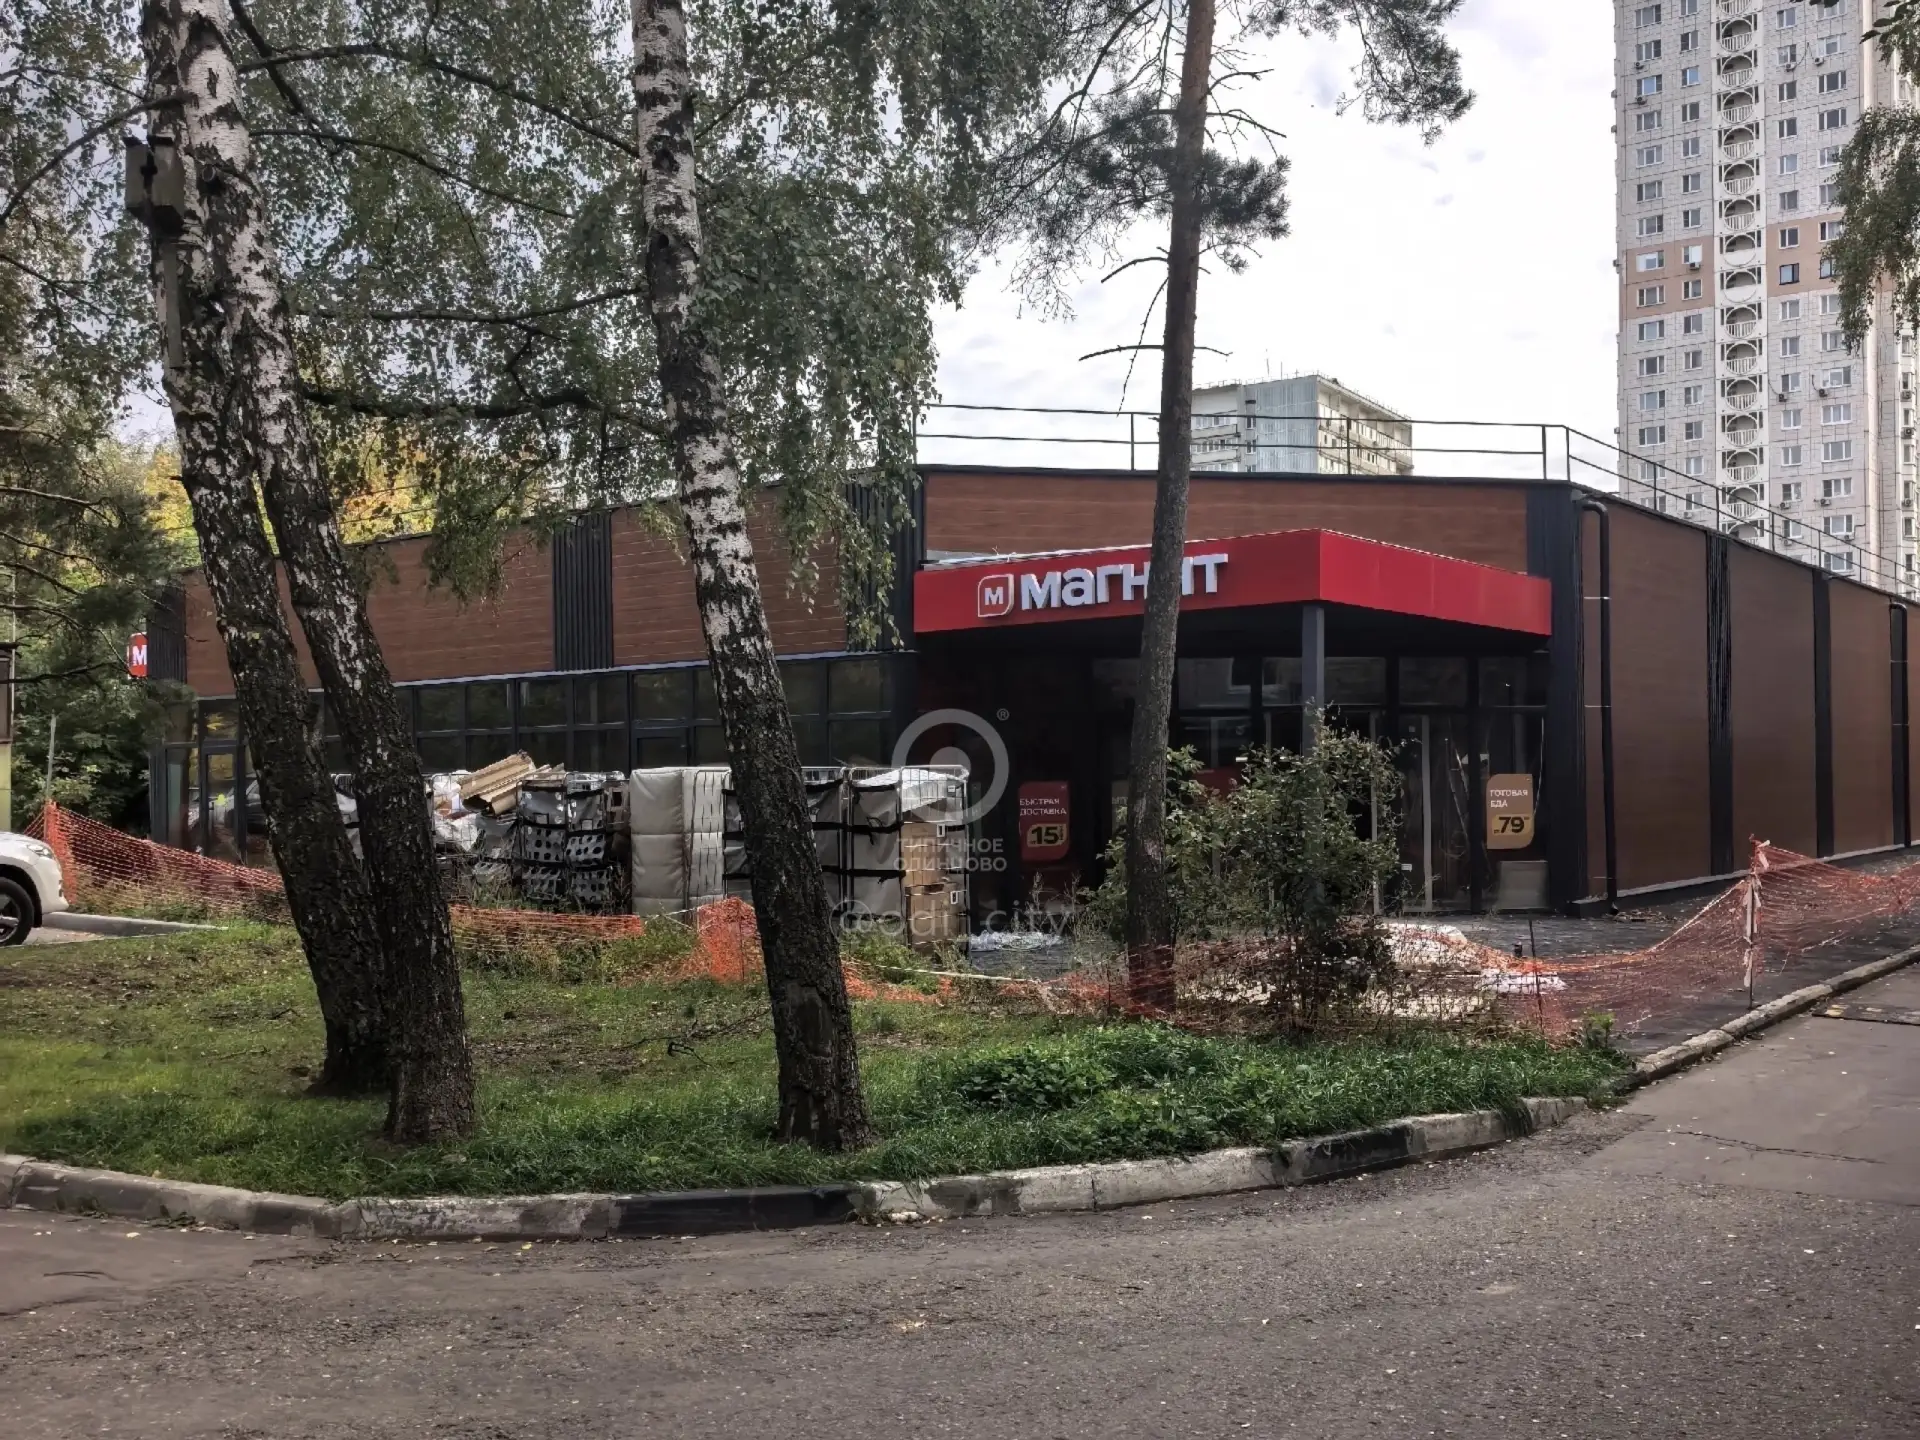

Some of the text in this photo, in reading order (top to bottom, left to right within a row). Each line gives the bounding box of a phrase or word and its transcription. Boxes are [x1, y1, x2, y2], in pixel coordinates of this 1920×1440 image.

[1489, 789, 1529, 797] ГОТОВАЯ
[1019, 798, 1060, 806] БЫСТРАЯ
[1490, 799, 1508, 808] ЕДА
[1019, 808, 1067, 817] ДОСТАВКА
[1498, 816, 1525, 834] 79
[1031, 826, 1059, 844] 15
